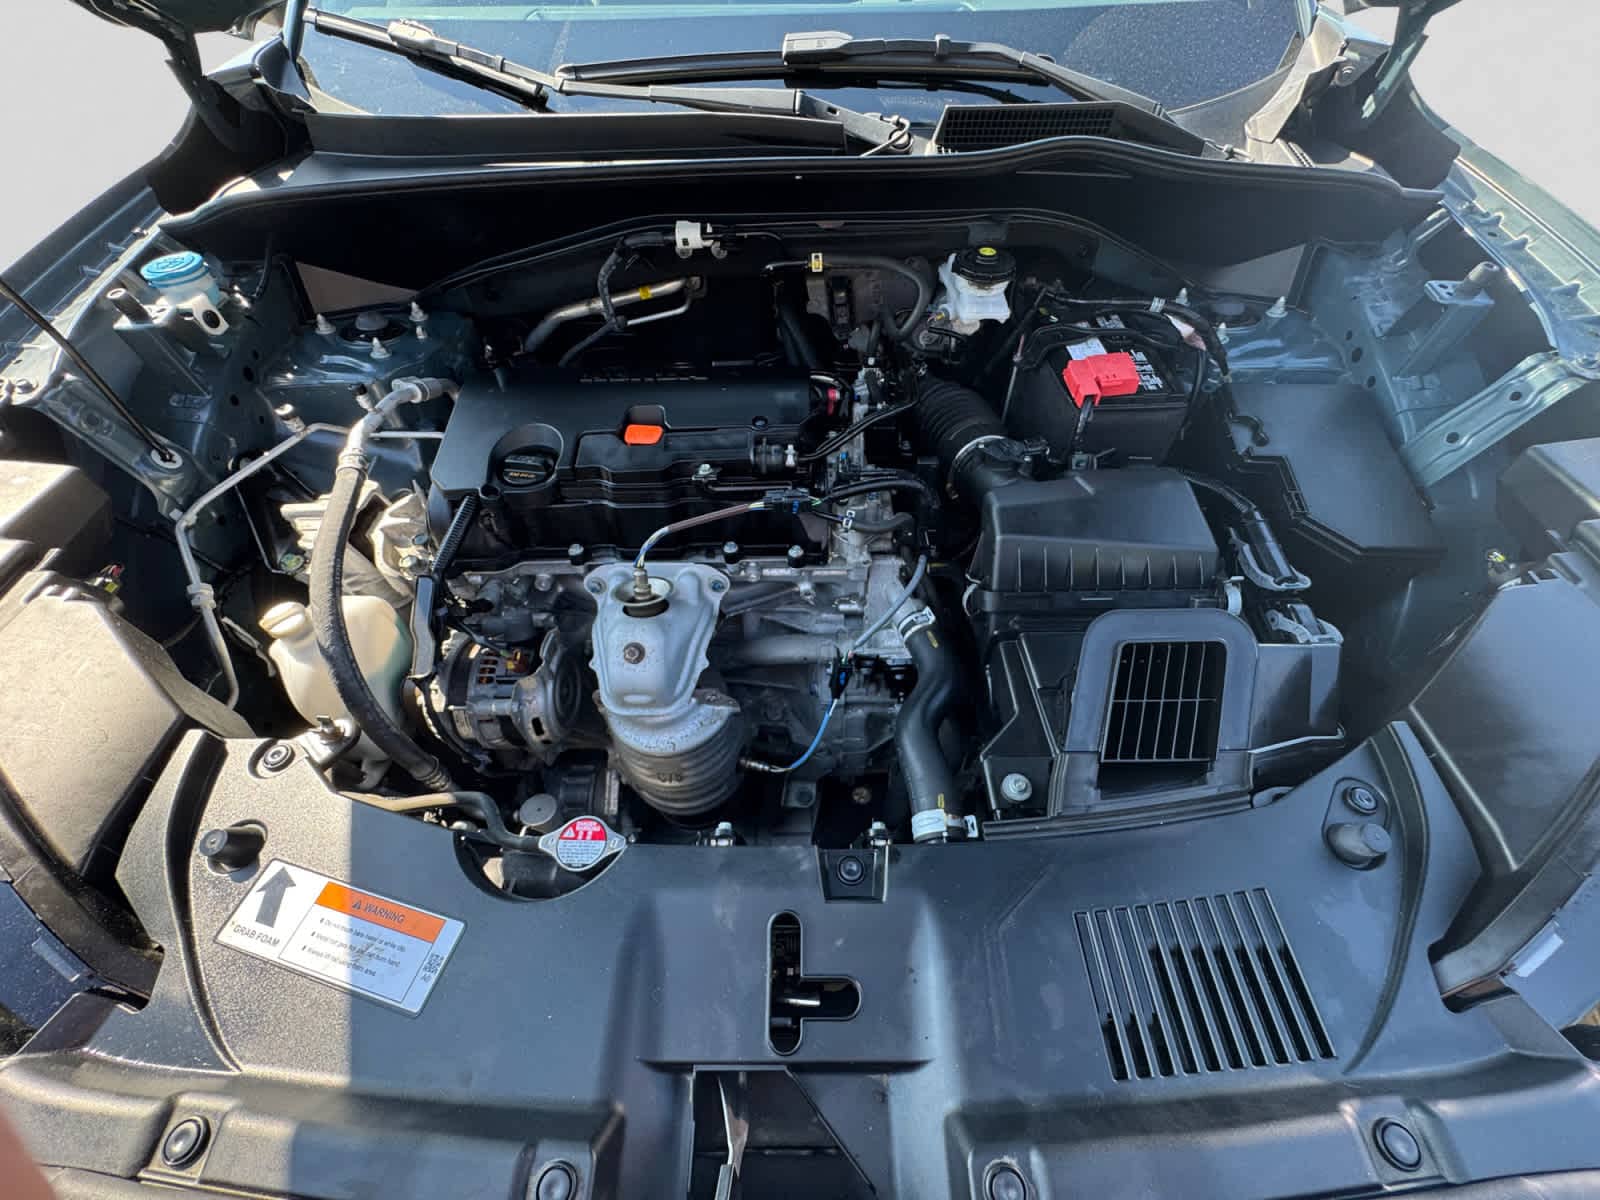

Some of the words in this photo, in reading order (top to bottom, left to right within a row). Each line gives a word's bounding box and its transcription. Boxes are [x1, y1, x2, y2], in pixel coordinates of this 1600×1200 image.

[365, 902, 405, 923] WARNING
[233, 924, 257, 939] GRAB
[256, 932, 281, 947] FOAM
